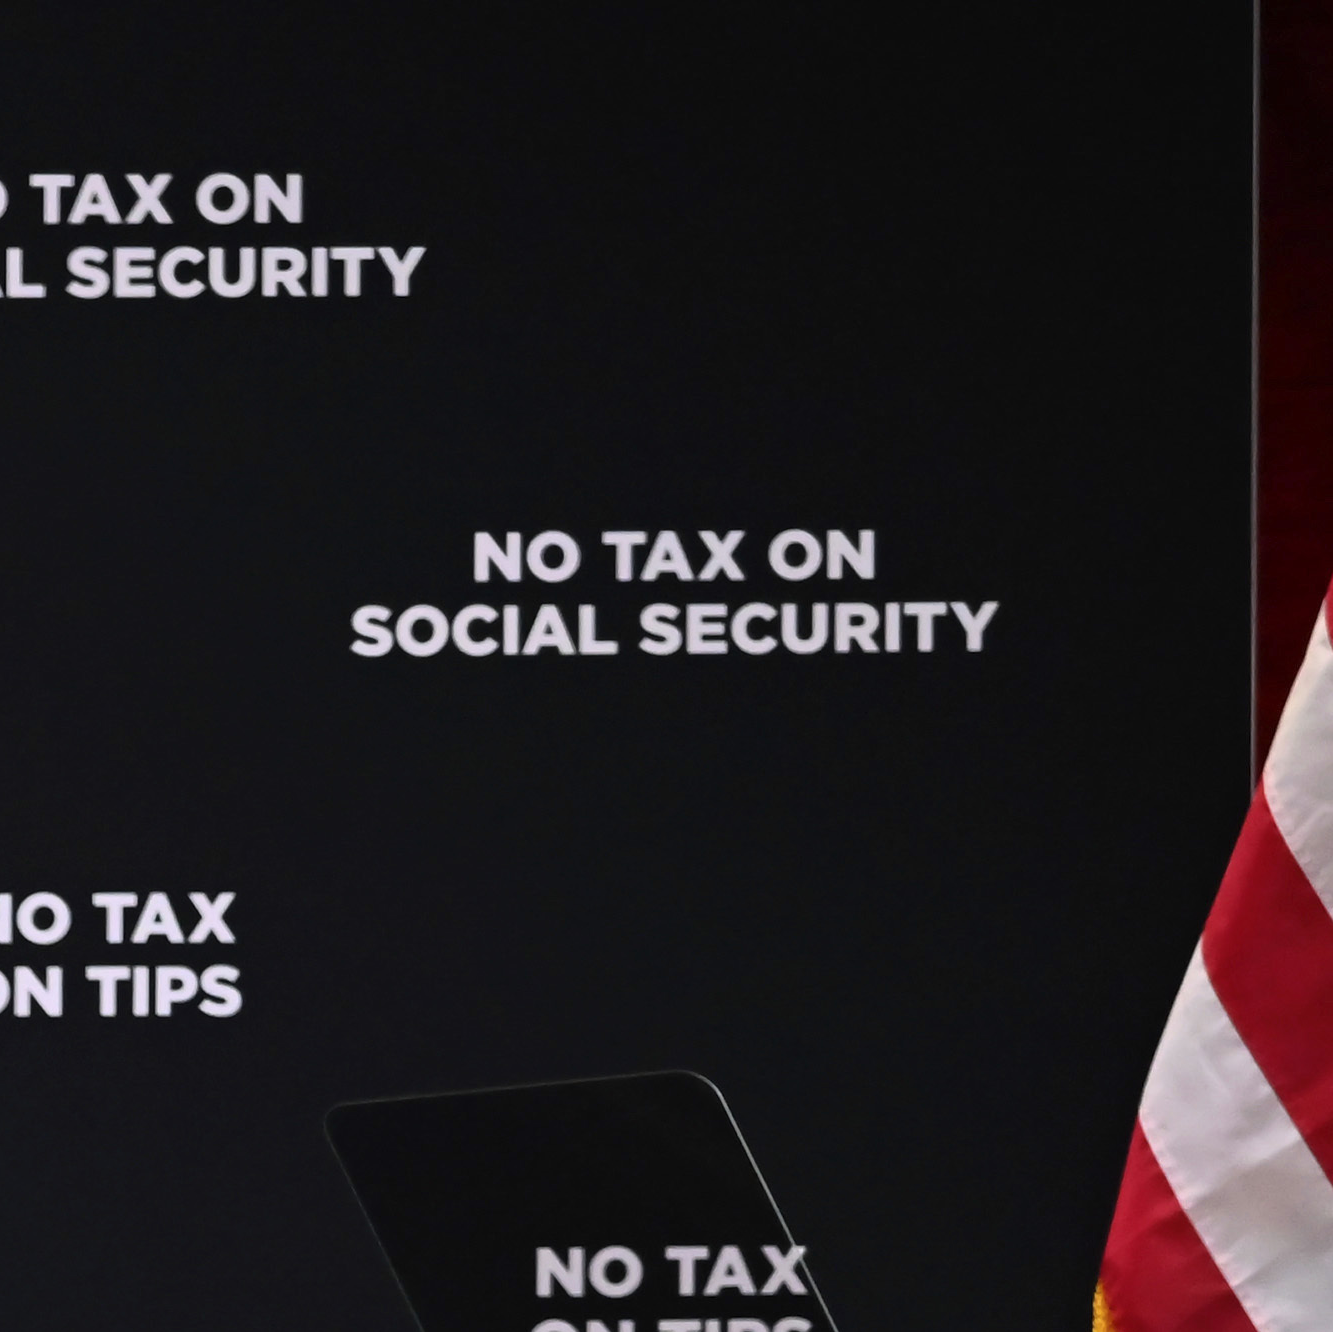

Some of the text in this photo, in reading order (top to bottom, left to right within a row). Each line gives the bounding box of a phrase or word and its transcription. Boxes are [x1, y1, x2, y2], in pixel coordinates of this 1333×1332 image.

[30, 173, 172, 225] TAX
[196, 173, 302, 225] ON
[67, 247, 425, 299] SECURITY
[474, 529, 874, 582] NO TAX ON
[351, 602, 998, 656] SOCIAL SECURITY
[92, 892, 235, 944] TAX
[86, 965, 242, 1018] TIPS
[536, 1244, 808, 1298] NO TAX
